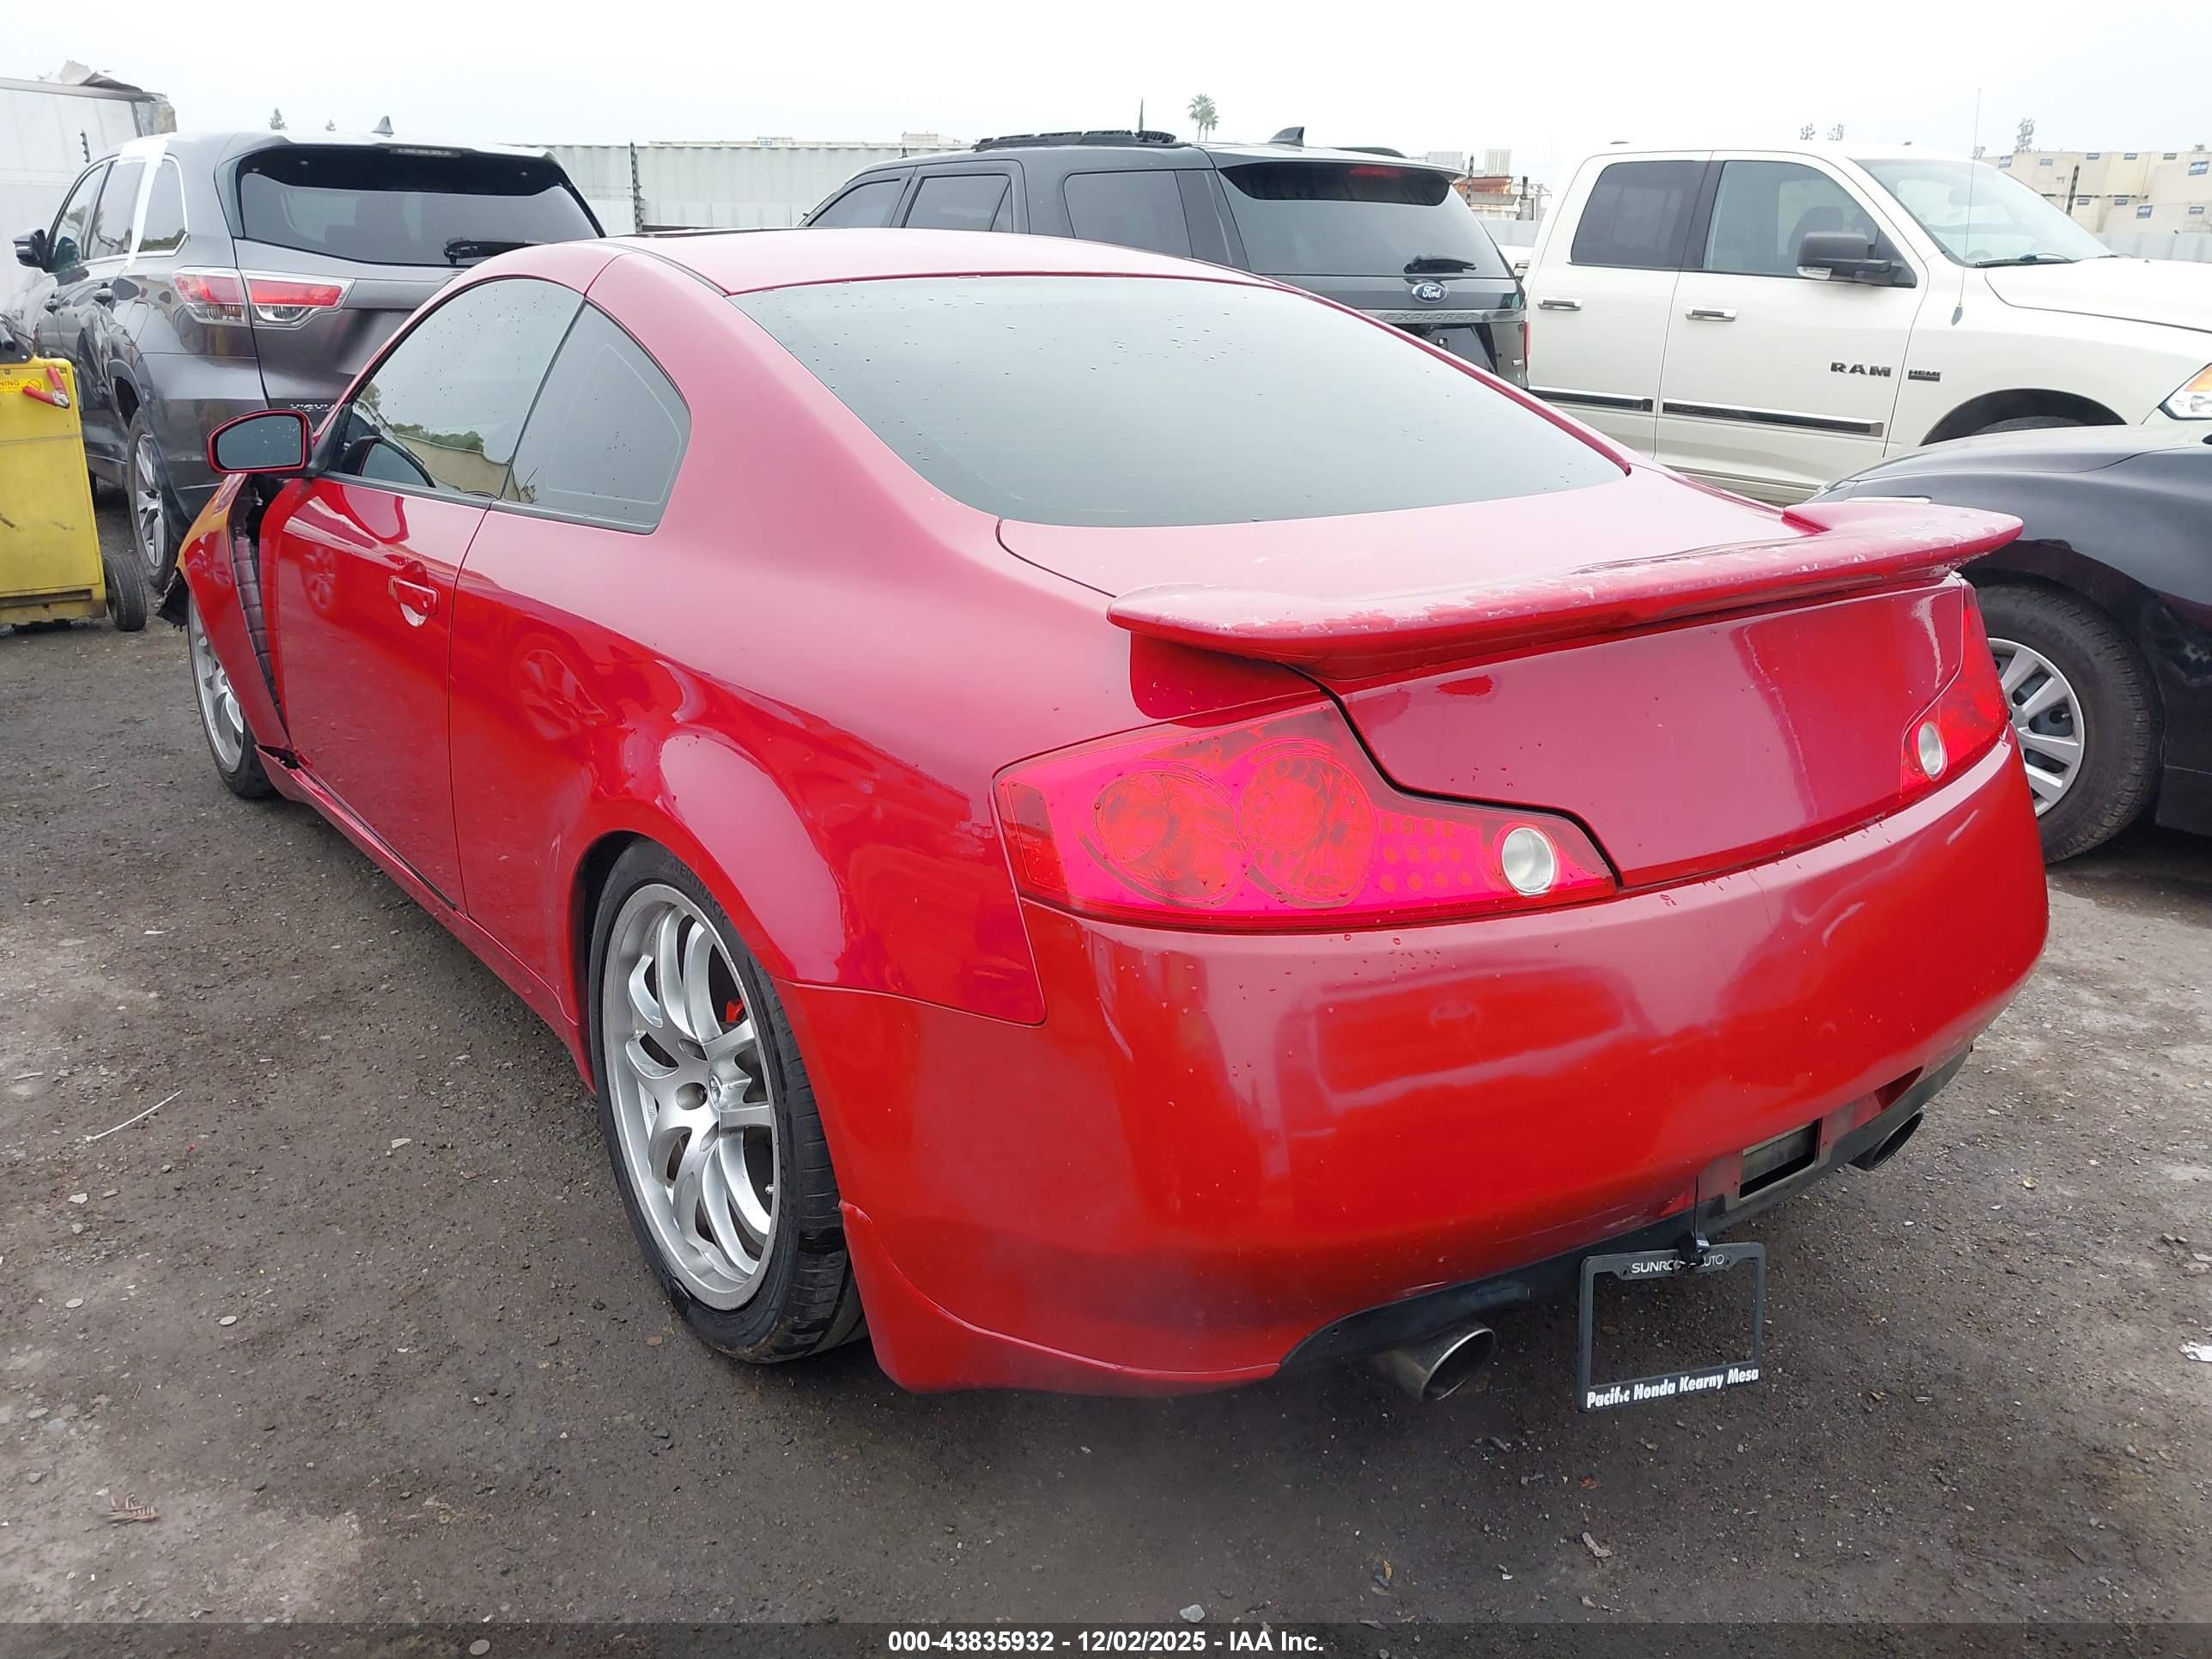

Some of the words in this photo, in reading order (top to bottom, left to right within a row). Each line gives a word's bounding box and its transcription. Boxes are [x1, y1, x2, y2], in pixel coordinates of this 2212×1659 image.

[1422, 285, 1441, 299] Ford
[1383, 313, 1480, 322] EXPLORER
[1830, 362, 1892, 377] RAM
[1908, 369, 1941, 378] HEMI
[1587, 1386, 1630, 1408] Pacific
[1633, 1379, 1675, 1401] Honda
[1679, 1373, 1724, 1392] Kearny
[1727, 1368, 1759, 1384] Mesa
